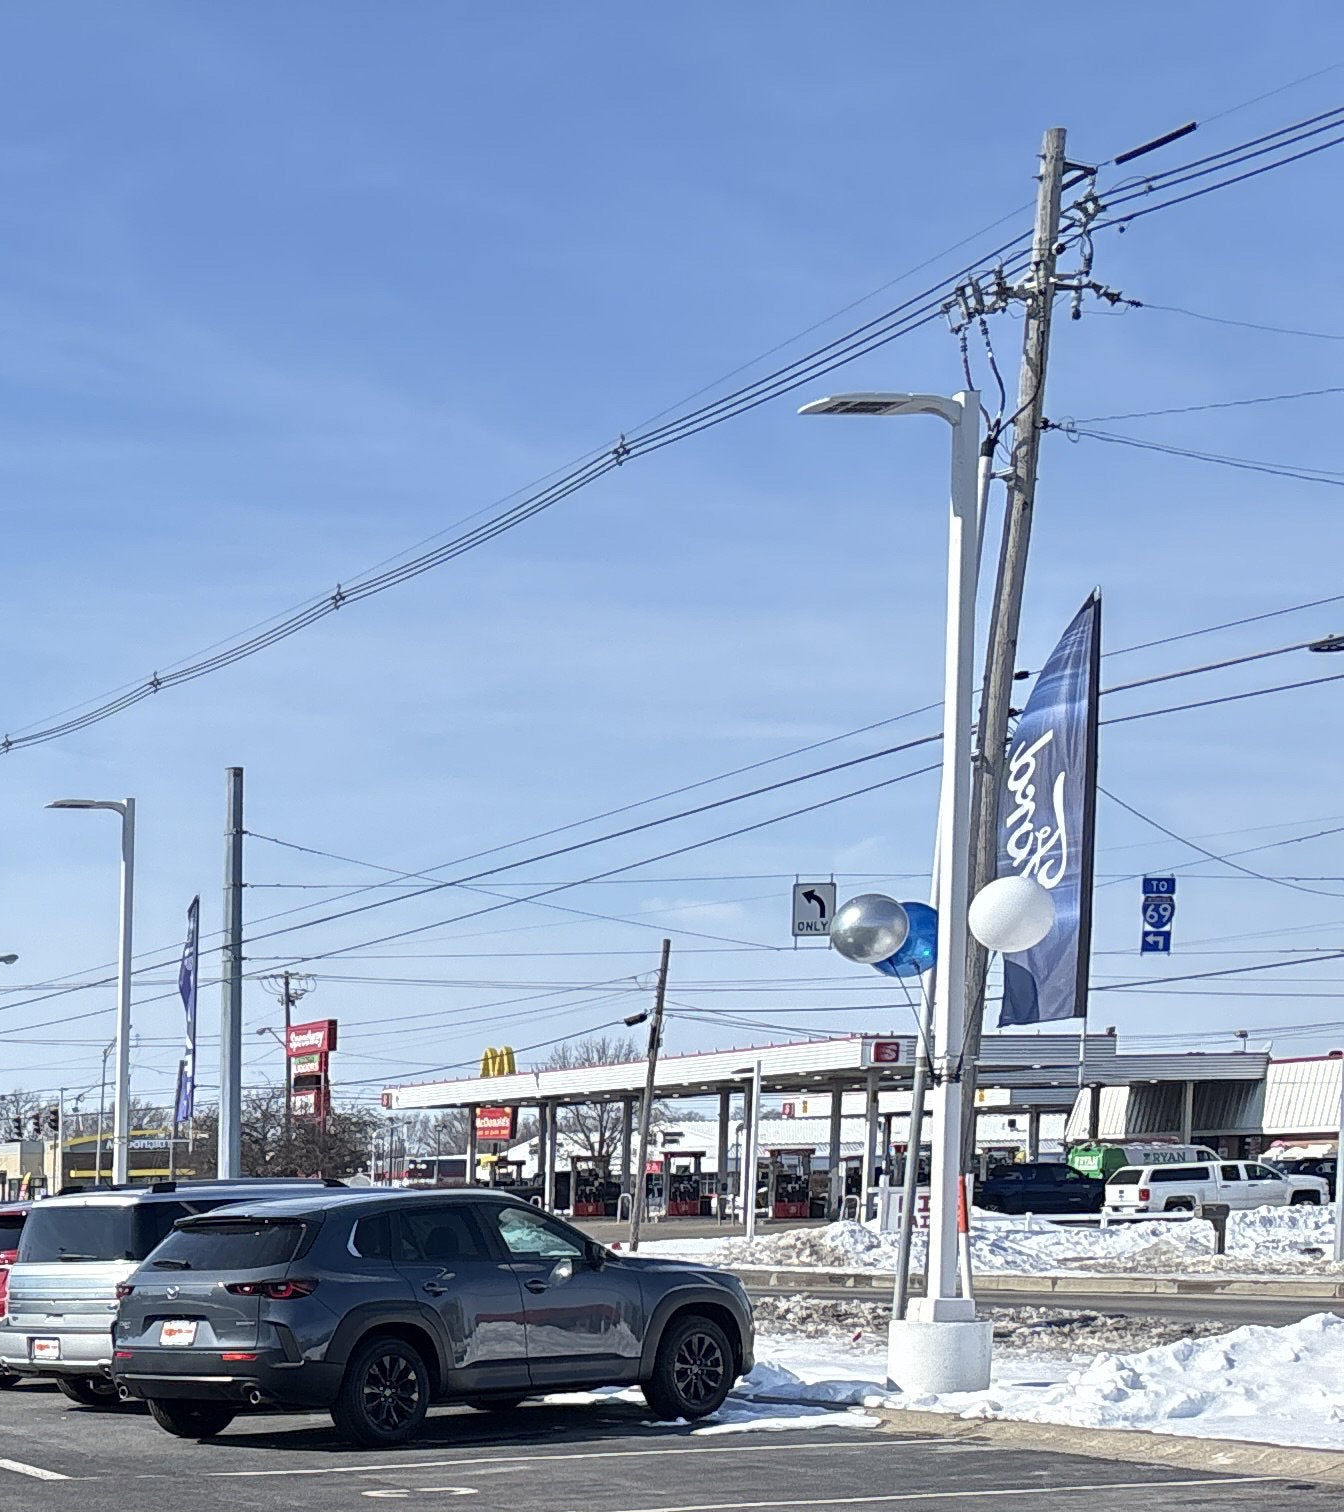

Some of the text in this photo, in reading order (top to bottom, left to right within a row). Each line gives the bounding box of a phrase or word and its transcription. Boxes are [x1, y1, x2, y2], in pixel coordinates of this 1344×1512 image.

[1151, 881, 1168, 892] TO
[1146, 904, 1172, 923] 69
[798, 921, 829, 932] ONLY
[1153, 1152, 1186, 1163] RYAN
